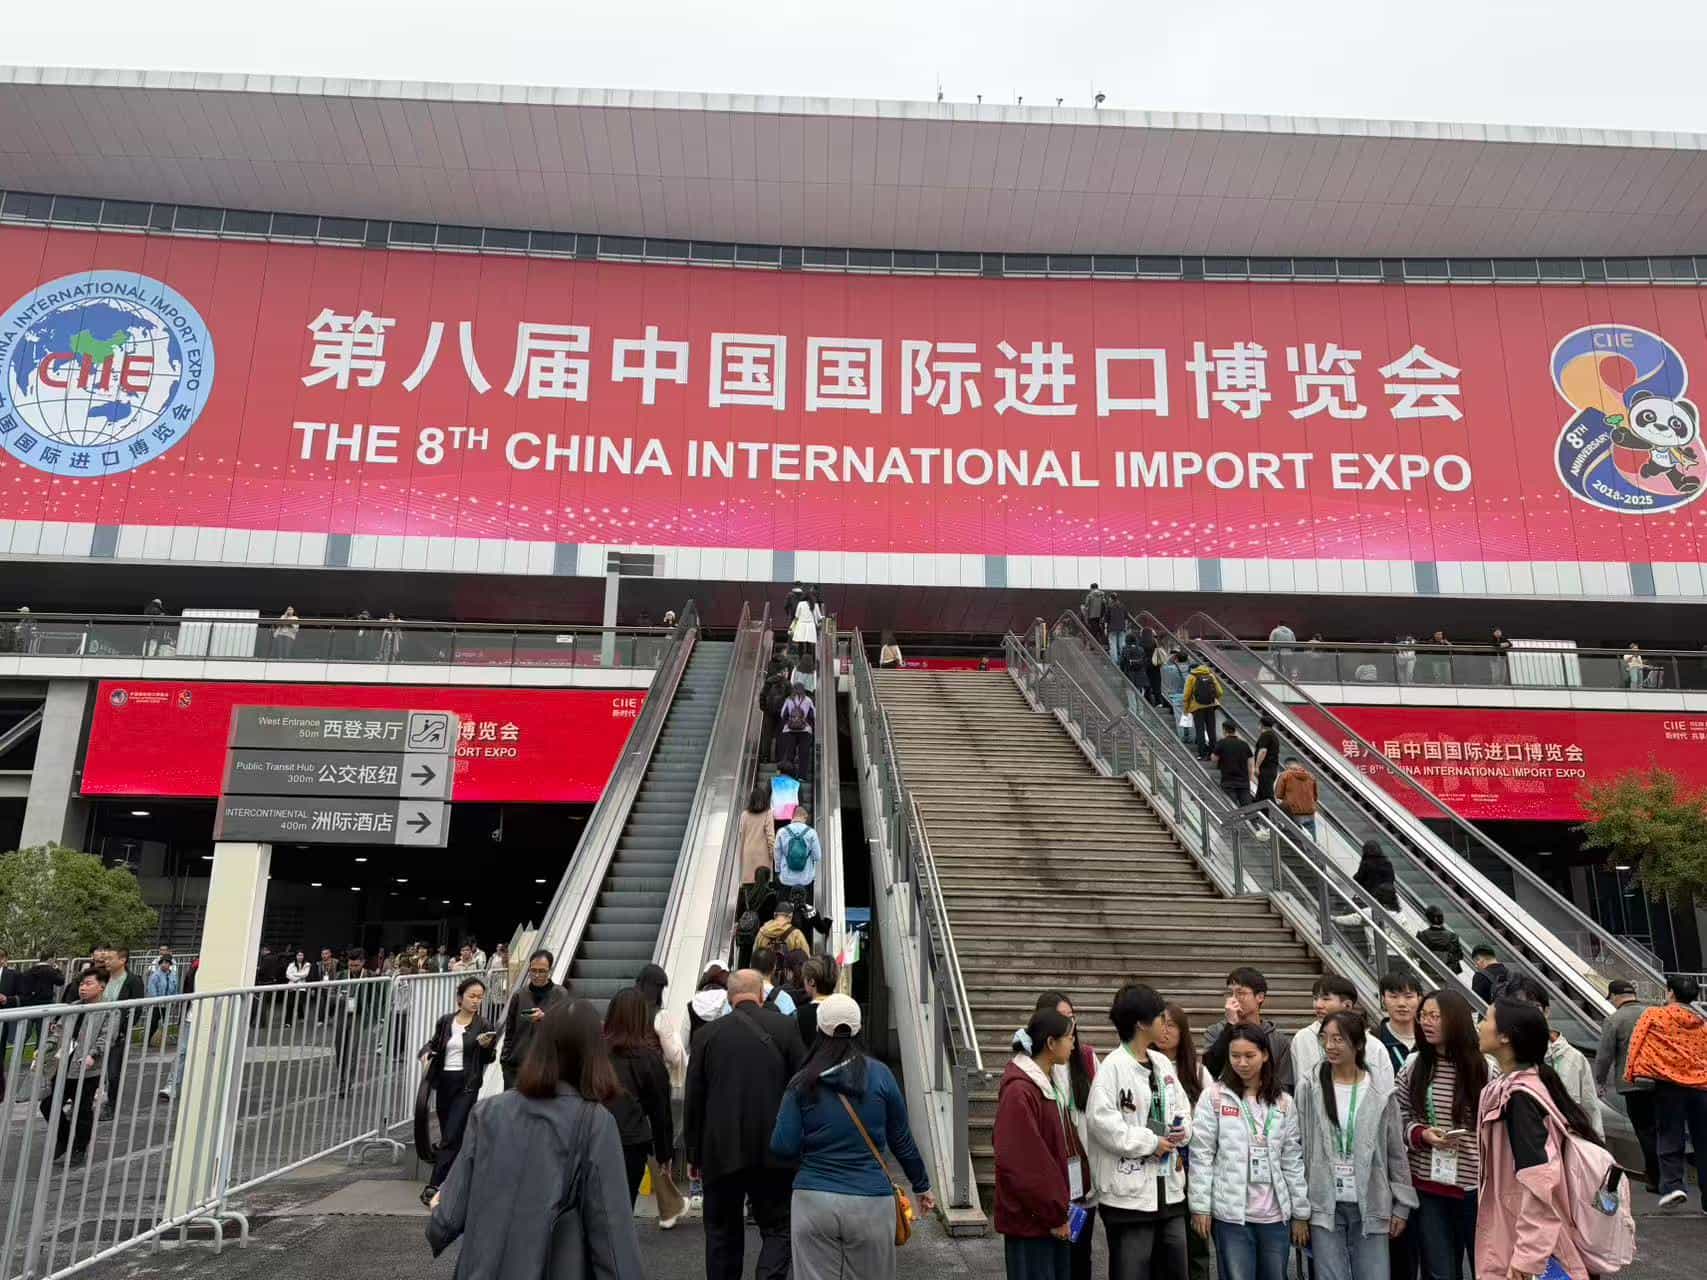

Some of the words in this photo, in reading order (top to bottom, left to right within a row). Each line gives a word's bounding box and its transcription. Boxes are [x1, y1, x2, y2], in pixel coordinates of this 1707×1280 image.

[15, 282, 147, 329] INTERNATIONAL
[151, 295, 197, 344] IMPORT
[186, 349, 201, 391] EXPO
[1593, 333, 1634, 348] CIIE
[39, 352, 154, 393] CIIE
[301, 308, 1464, 421] 第八届中国国际进口博览会
[1566, 423, 1589, 449] 8TH
[293, 421, 400, 464] THE
[416, 426, 489, 465] 8TH
[504, 432, 673, 476] CHINA
[687, 439, 1100, 488] INTERNATIONAL
[1114, 450, 1314, 491] IMPORT
[1330, 453, 1473, 493] EXPO
[1570, 432, 1610, 477] ANNIVERSARY
[1592, 480, 1654, 505] 2018-2025
[258, 716, 280, 726] West
[282, 718, 320, 727] Entrance
[323, 719, 403, 741] 西登录厅
[299, 730, 319, 738] 50m
[454, 746, 482, 757] ORT
[484, 747, 517, 758] EXPO
[236, 761, 264, 771] Public
[266, 762, 294, 772] Transit
[296, 763, 314, 772] Hub
[318, 764, 398, 785] 公交枢纽
[1423, 766, 1510, 777] INTERNATIONAL
[1512, 767, 1553, 778] IMPORT
[1556, 768, 1586, 778] EXPO
[287, 774, 314, 784] 300m
[225, 808, 306, 818] INTERCONTINENTAL
[311, 811, 393, 832] 洲际酒店
[280, 822, 307, 831] 400m
